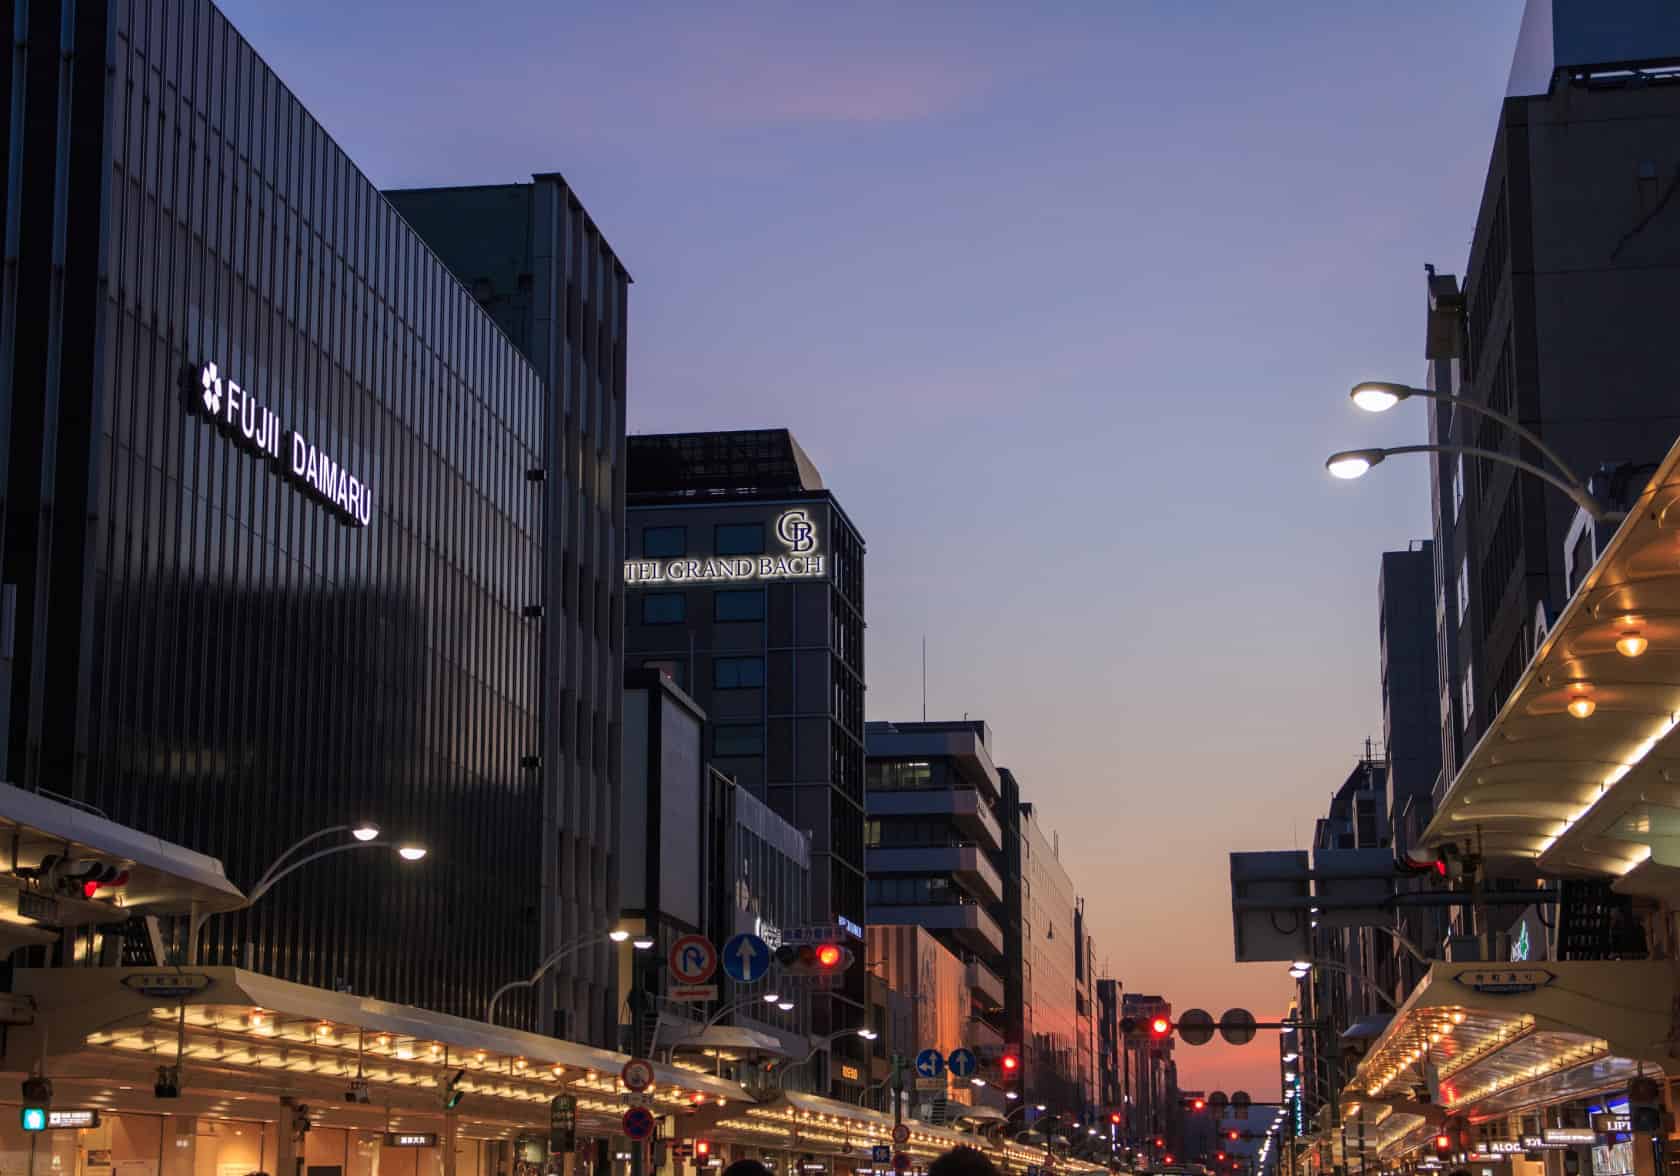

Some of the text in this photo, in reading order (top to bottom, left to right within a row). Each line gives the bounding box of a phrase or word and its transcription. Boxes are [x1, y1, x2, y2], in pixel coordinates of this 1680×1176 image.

[227, 380, 372, 526] FUJII DAIMARU
[666, 558, 754, 580] GRAND
[759, 555, 824, 577] BACH
